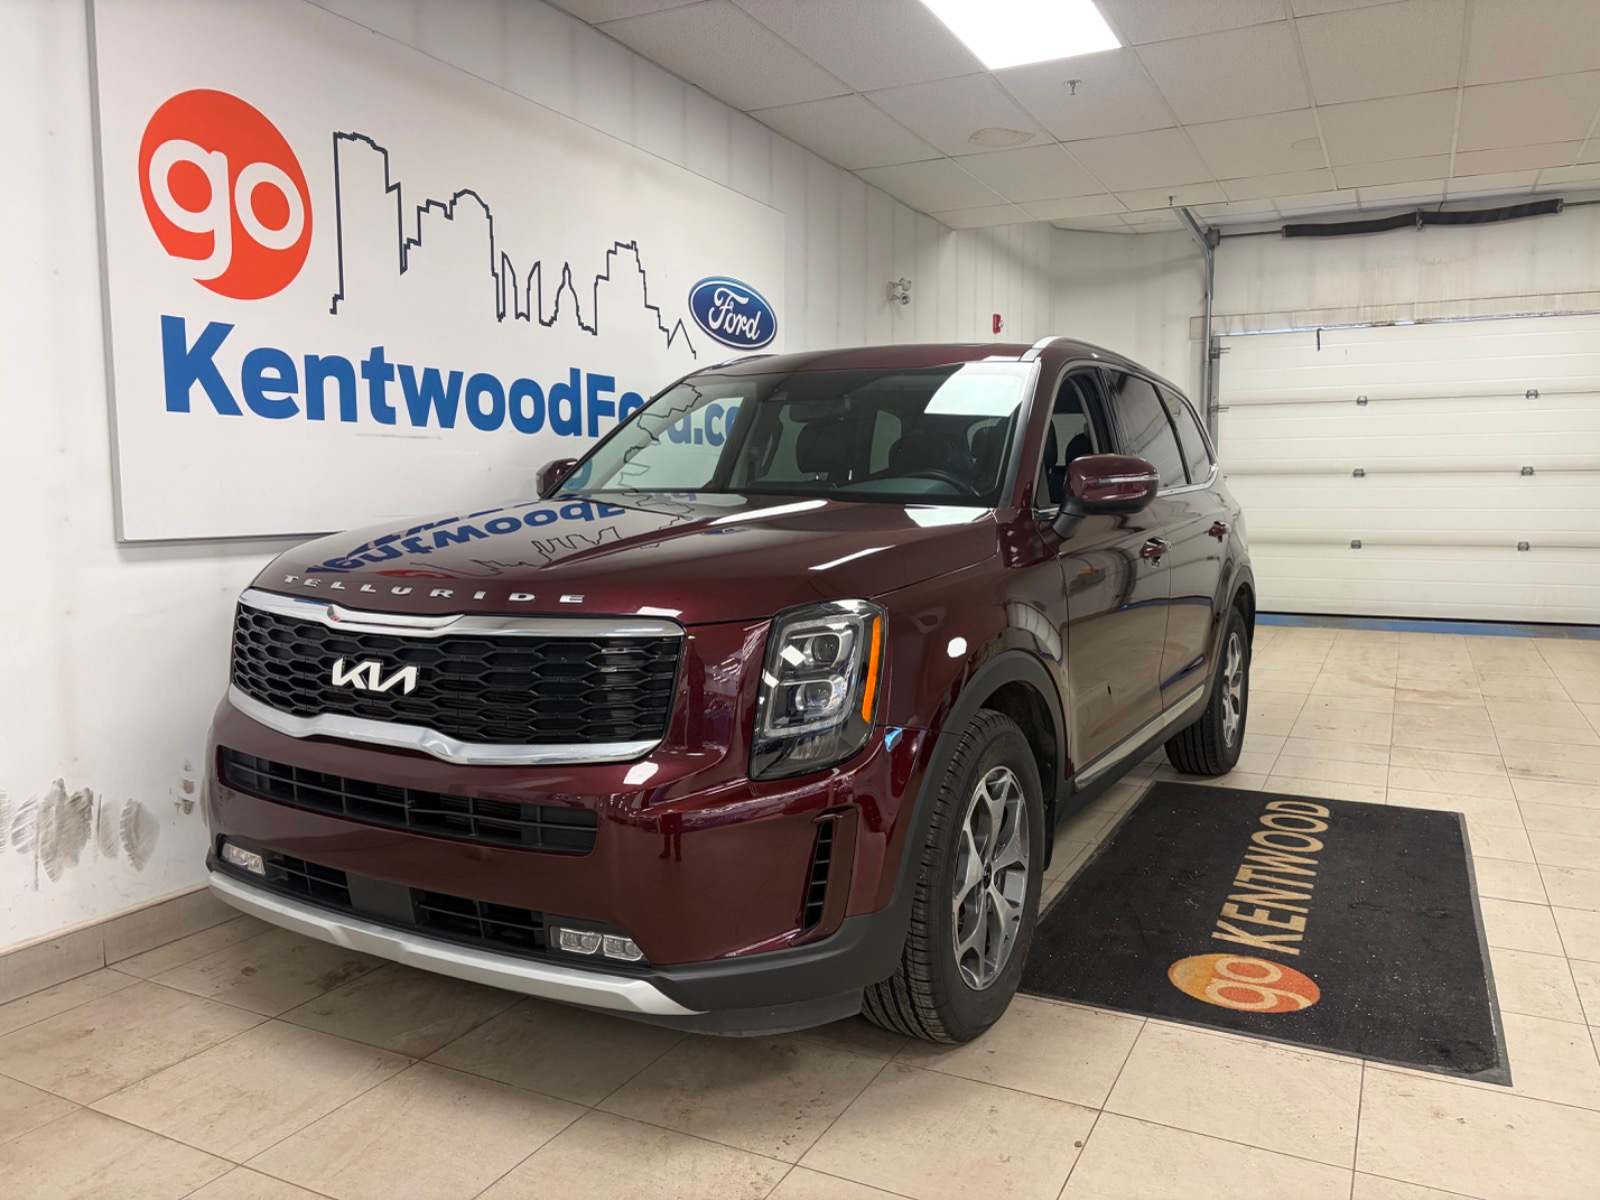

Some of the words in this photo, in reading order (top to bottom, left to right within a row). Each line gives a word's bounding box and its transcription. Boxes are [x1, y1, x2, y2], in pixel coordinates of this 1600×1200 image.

[149, 139, 304, 281] go
[708, 287, 761, 340] Ford
[283, 574, 585, 604] TELLURIDE
[1211, 800, 1330, 955] KENTWOOD
[1205, 955, 1313, 1009] go
